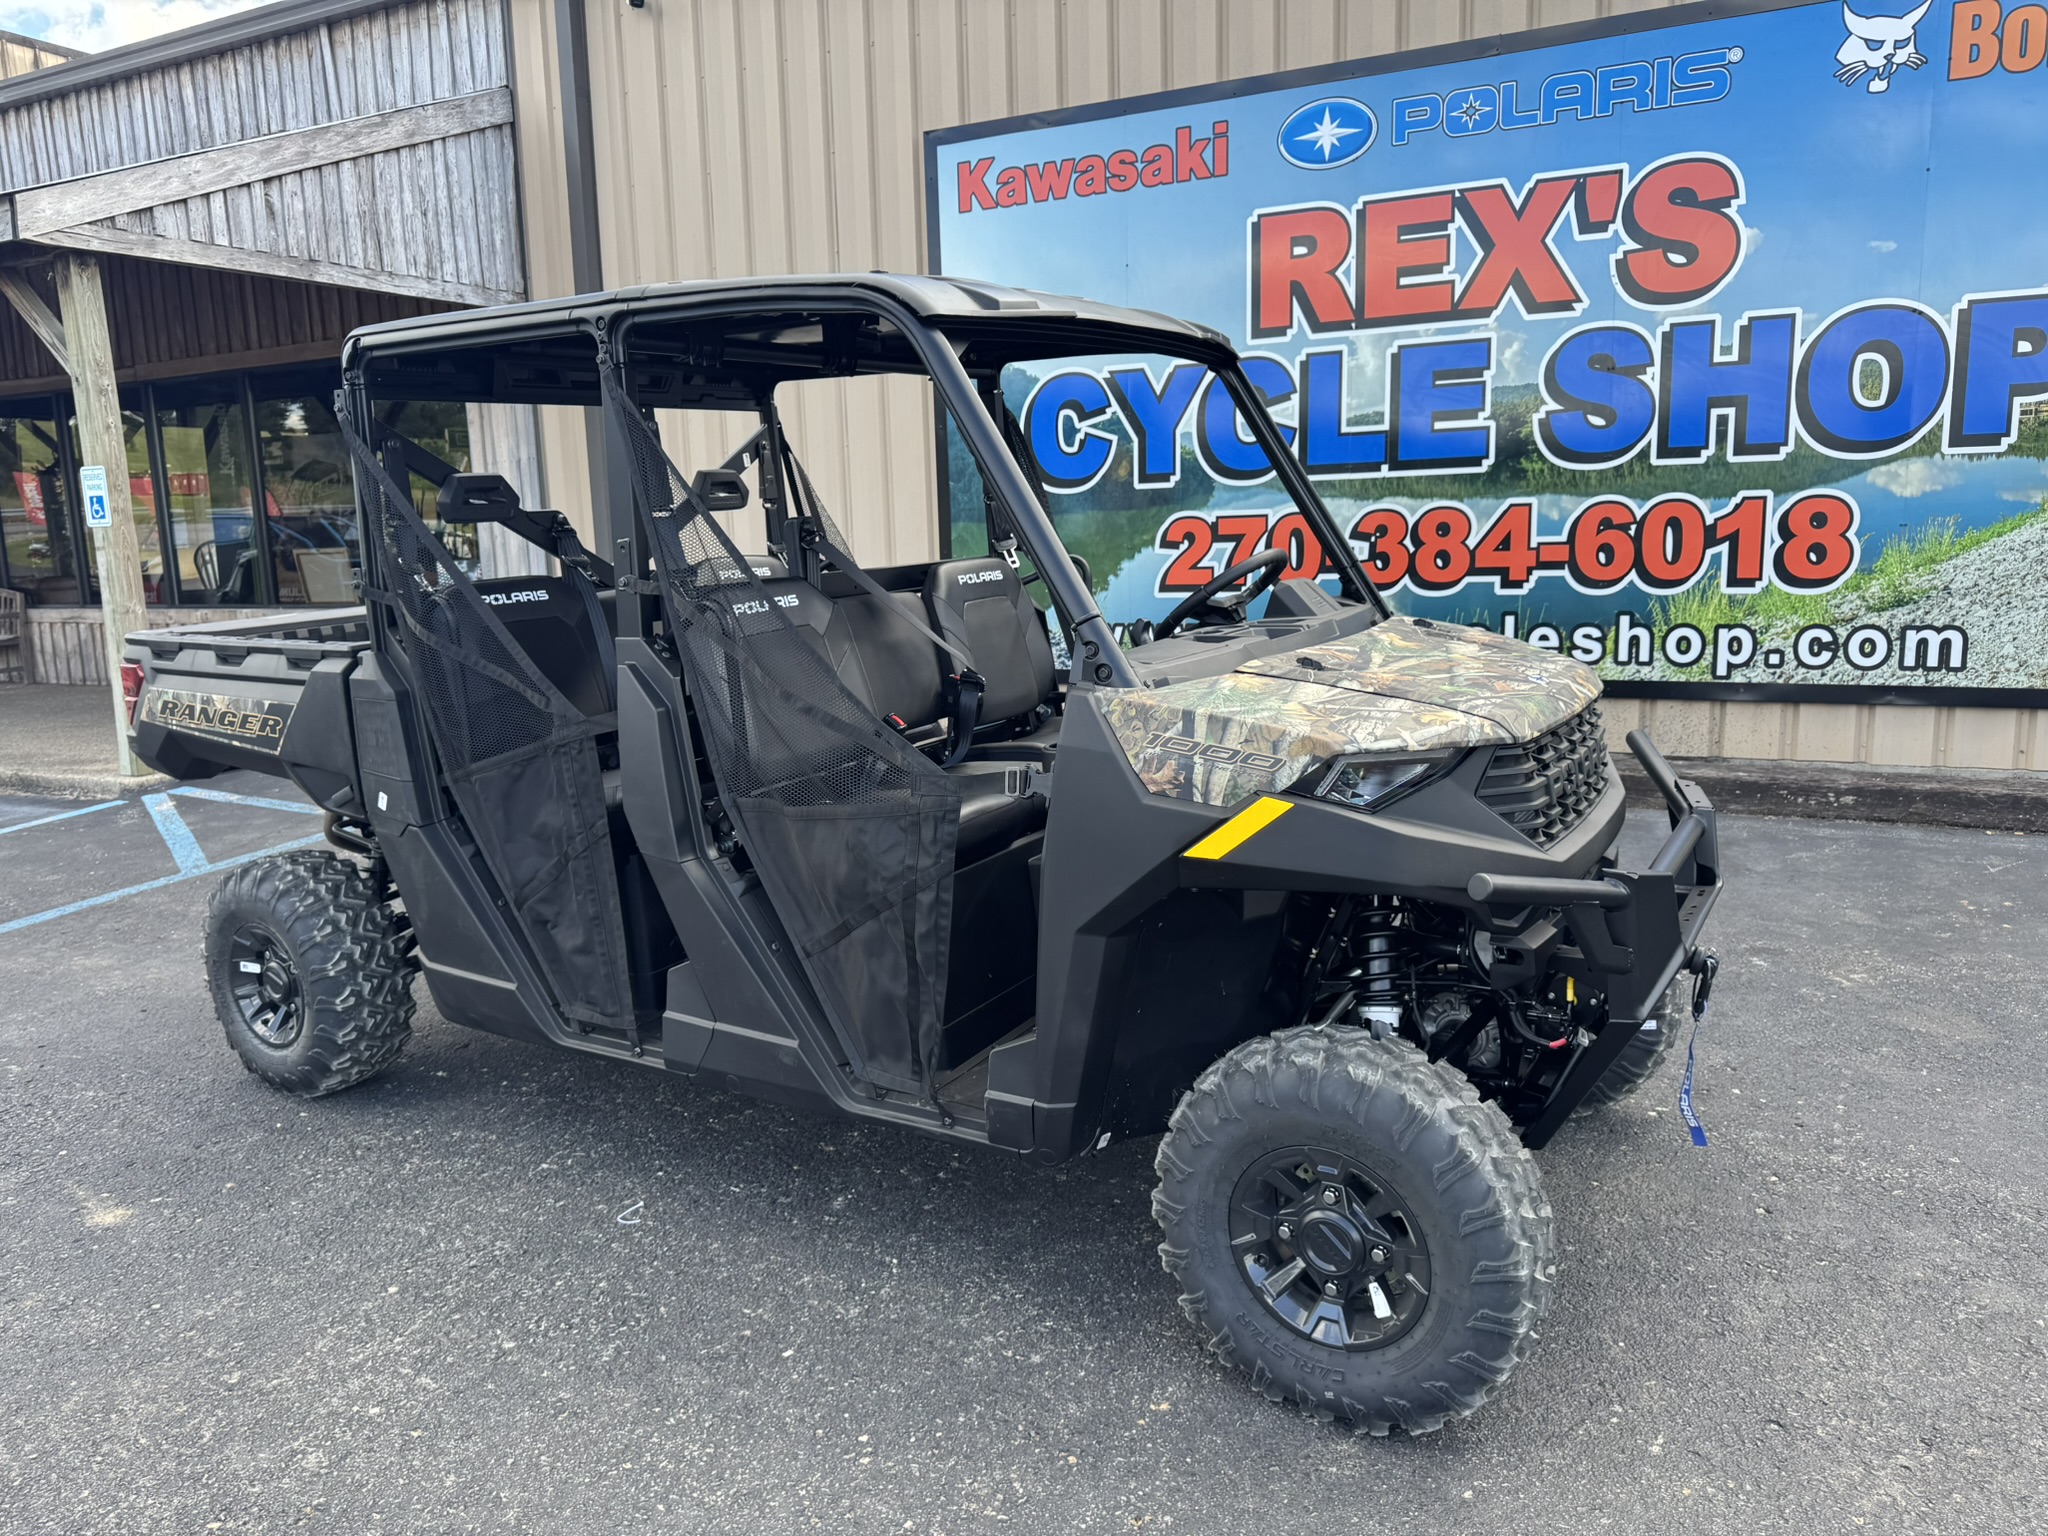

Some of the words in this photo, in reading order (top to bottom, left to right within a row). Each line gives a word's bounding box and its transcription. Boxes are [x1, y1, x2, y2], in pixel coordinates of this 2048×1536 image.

[957, 120, 1229, 213] Kawasaki
[1252, 157, 1741, 339] REX'S
[1025, 338, 1491, 486] CYCLE
[1539, 293, 2048, 464] SHOP
[719, 566, 771, 580] POLRIS
[957, 570, 1004, 585] POLARIS
[1160, 494, 1856, 592] 270384-6018
[158, 699, 283, 738] RANGER
[1142, 731, 1287, 773] 1000
[1236, 1310, 1345, 1385] CARLSTAR
